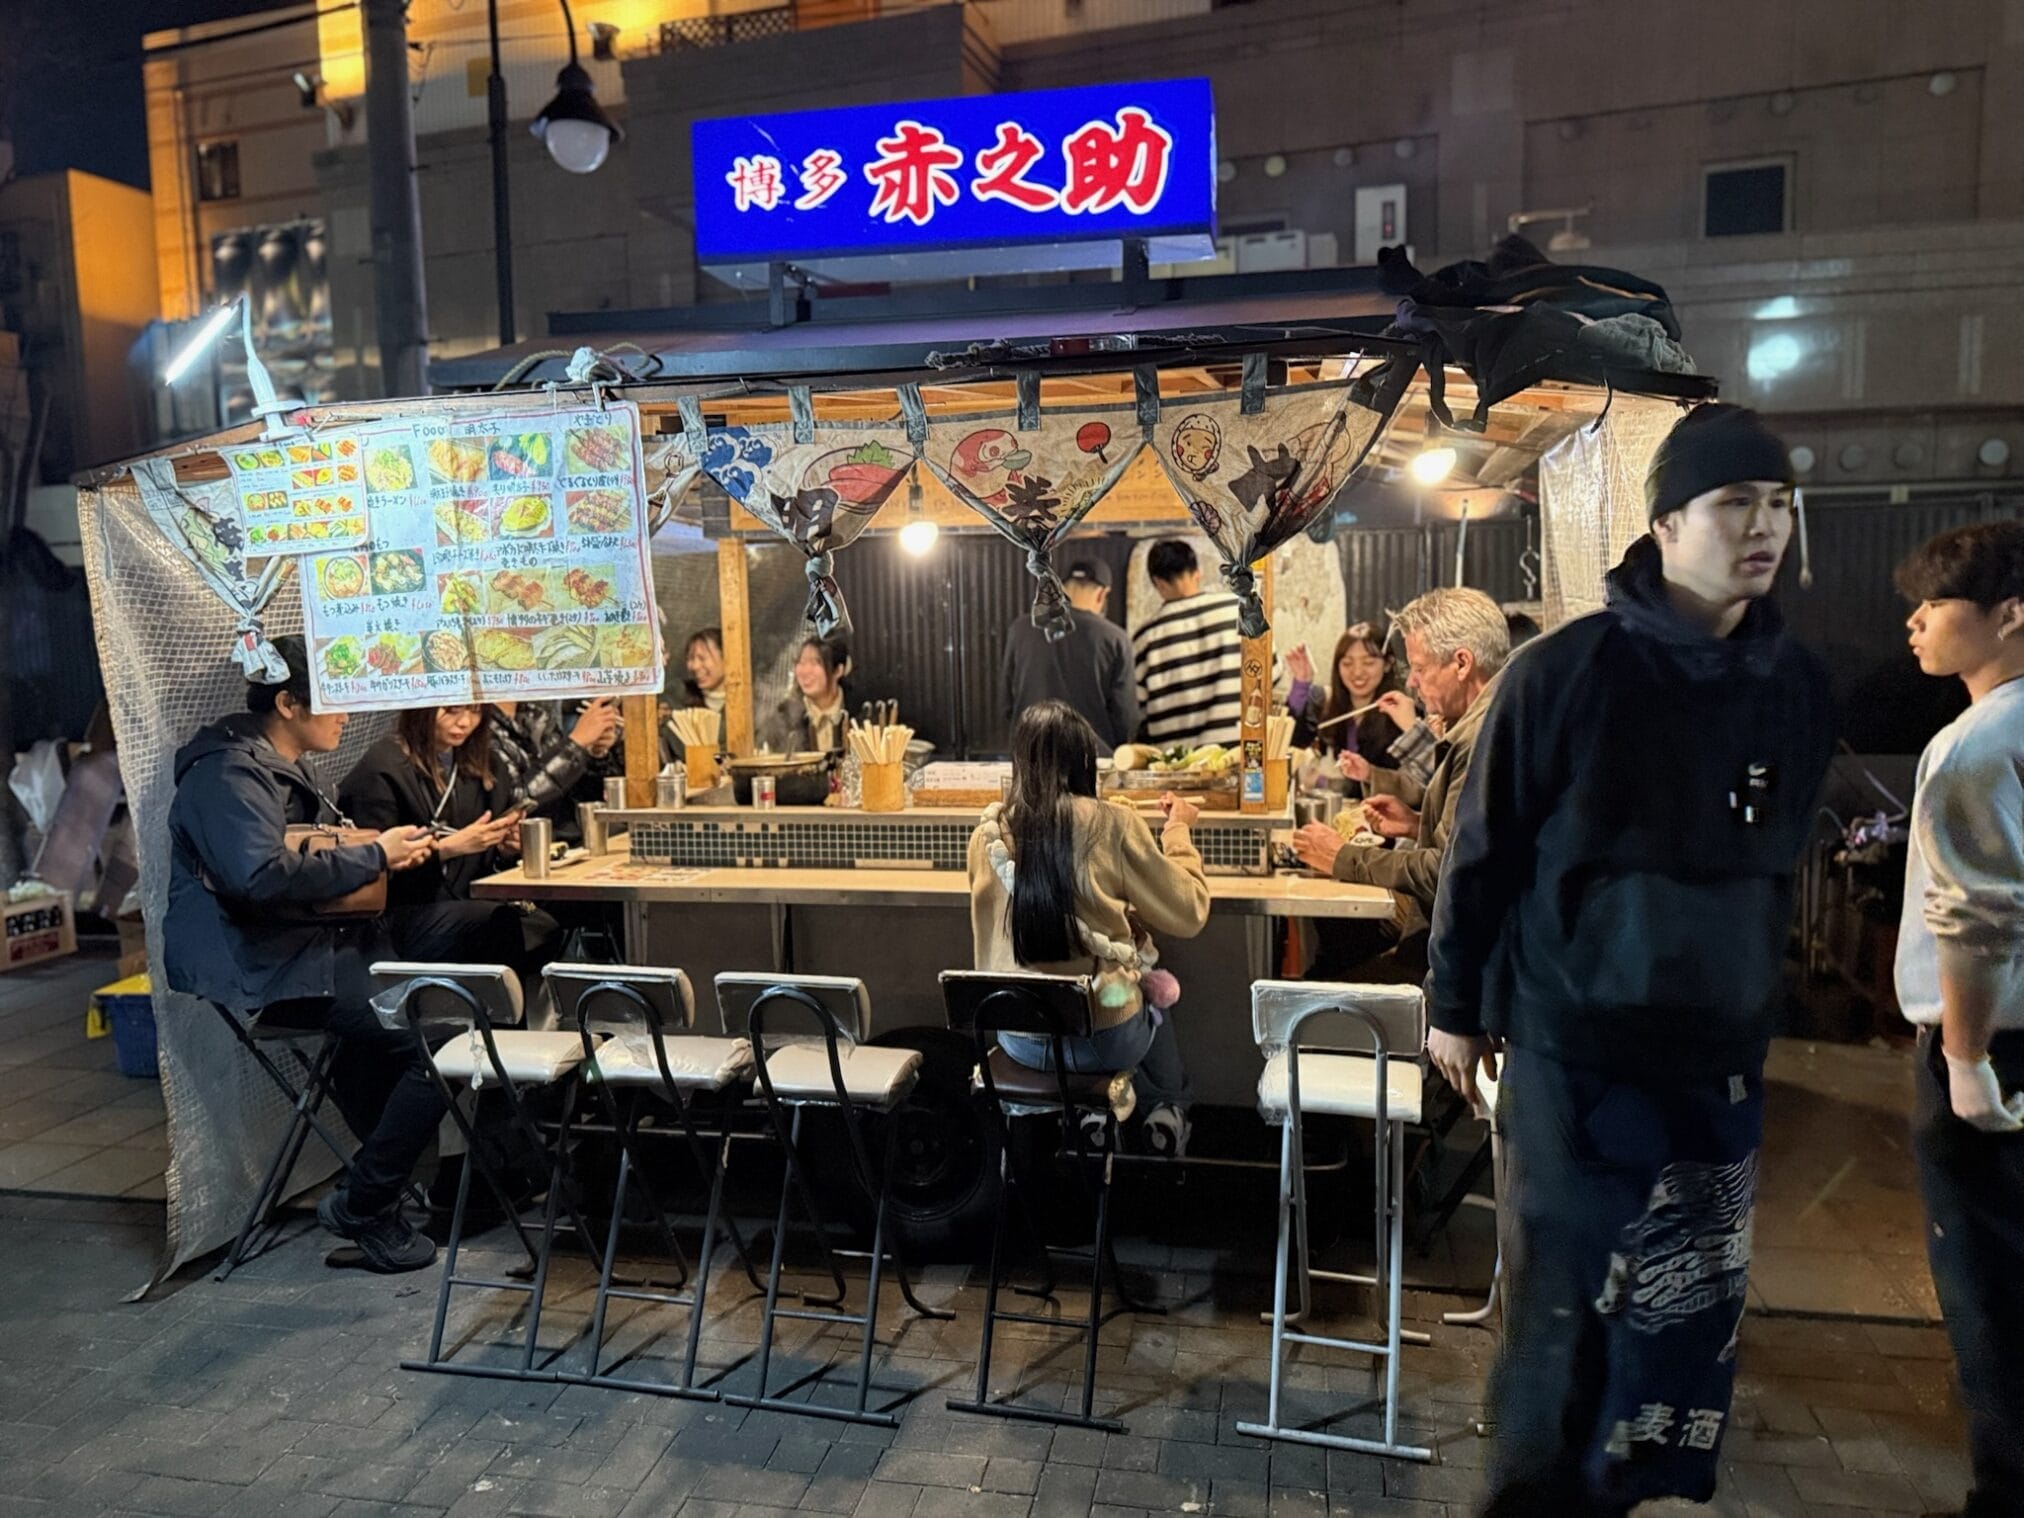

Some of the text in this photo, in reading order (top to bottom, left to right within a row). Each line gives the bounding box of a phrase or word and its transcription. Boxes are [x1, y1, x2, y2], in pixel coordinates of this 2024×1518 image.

[726, 105, 1173, 225] 博多 赤之助
